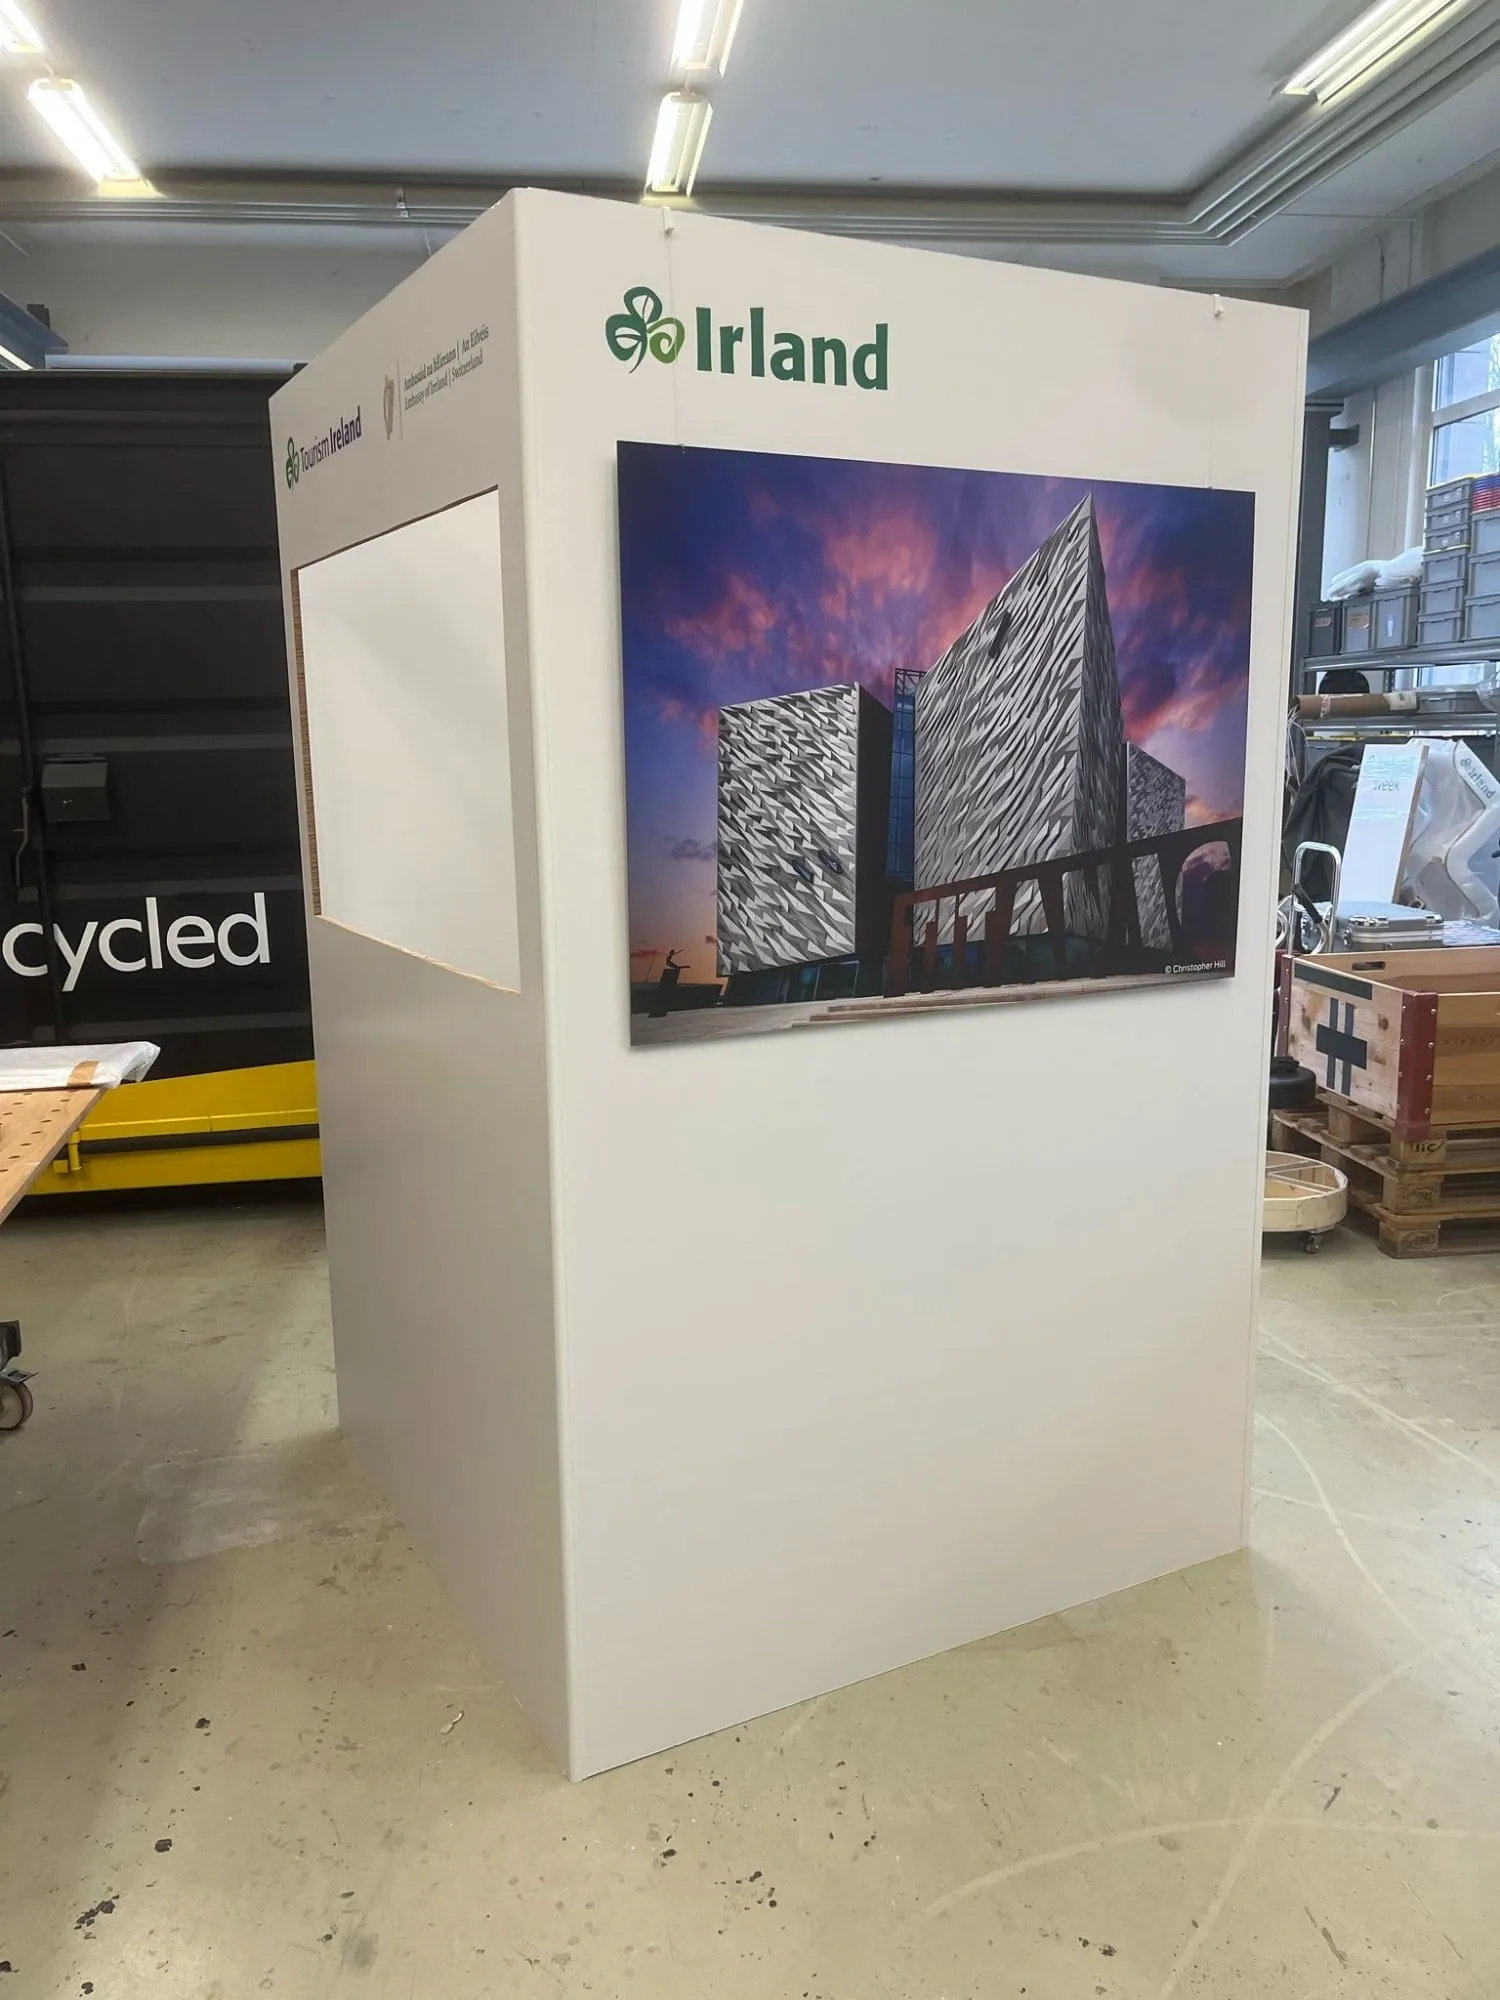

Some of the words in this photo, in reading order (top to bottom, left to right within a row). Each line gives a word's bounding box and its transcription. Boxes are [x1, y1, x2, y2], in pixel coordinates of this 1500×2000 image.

[404, 390, 424, 411] Embassy
[431, 371, 447, 394] Ireland
[452, 348, 483, 381] Switzerland
[696, 306, 888, 391] Irland
[300, 436, 330, 472] Tourism
[329, 404, 361, 454] Ireland
[2, 892, 270, 992] cycled
[1173, 961, 1213, 974] Christopher
[1214, 960, 1226, 969] Hill
